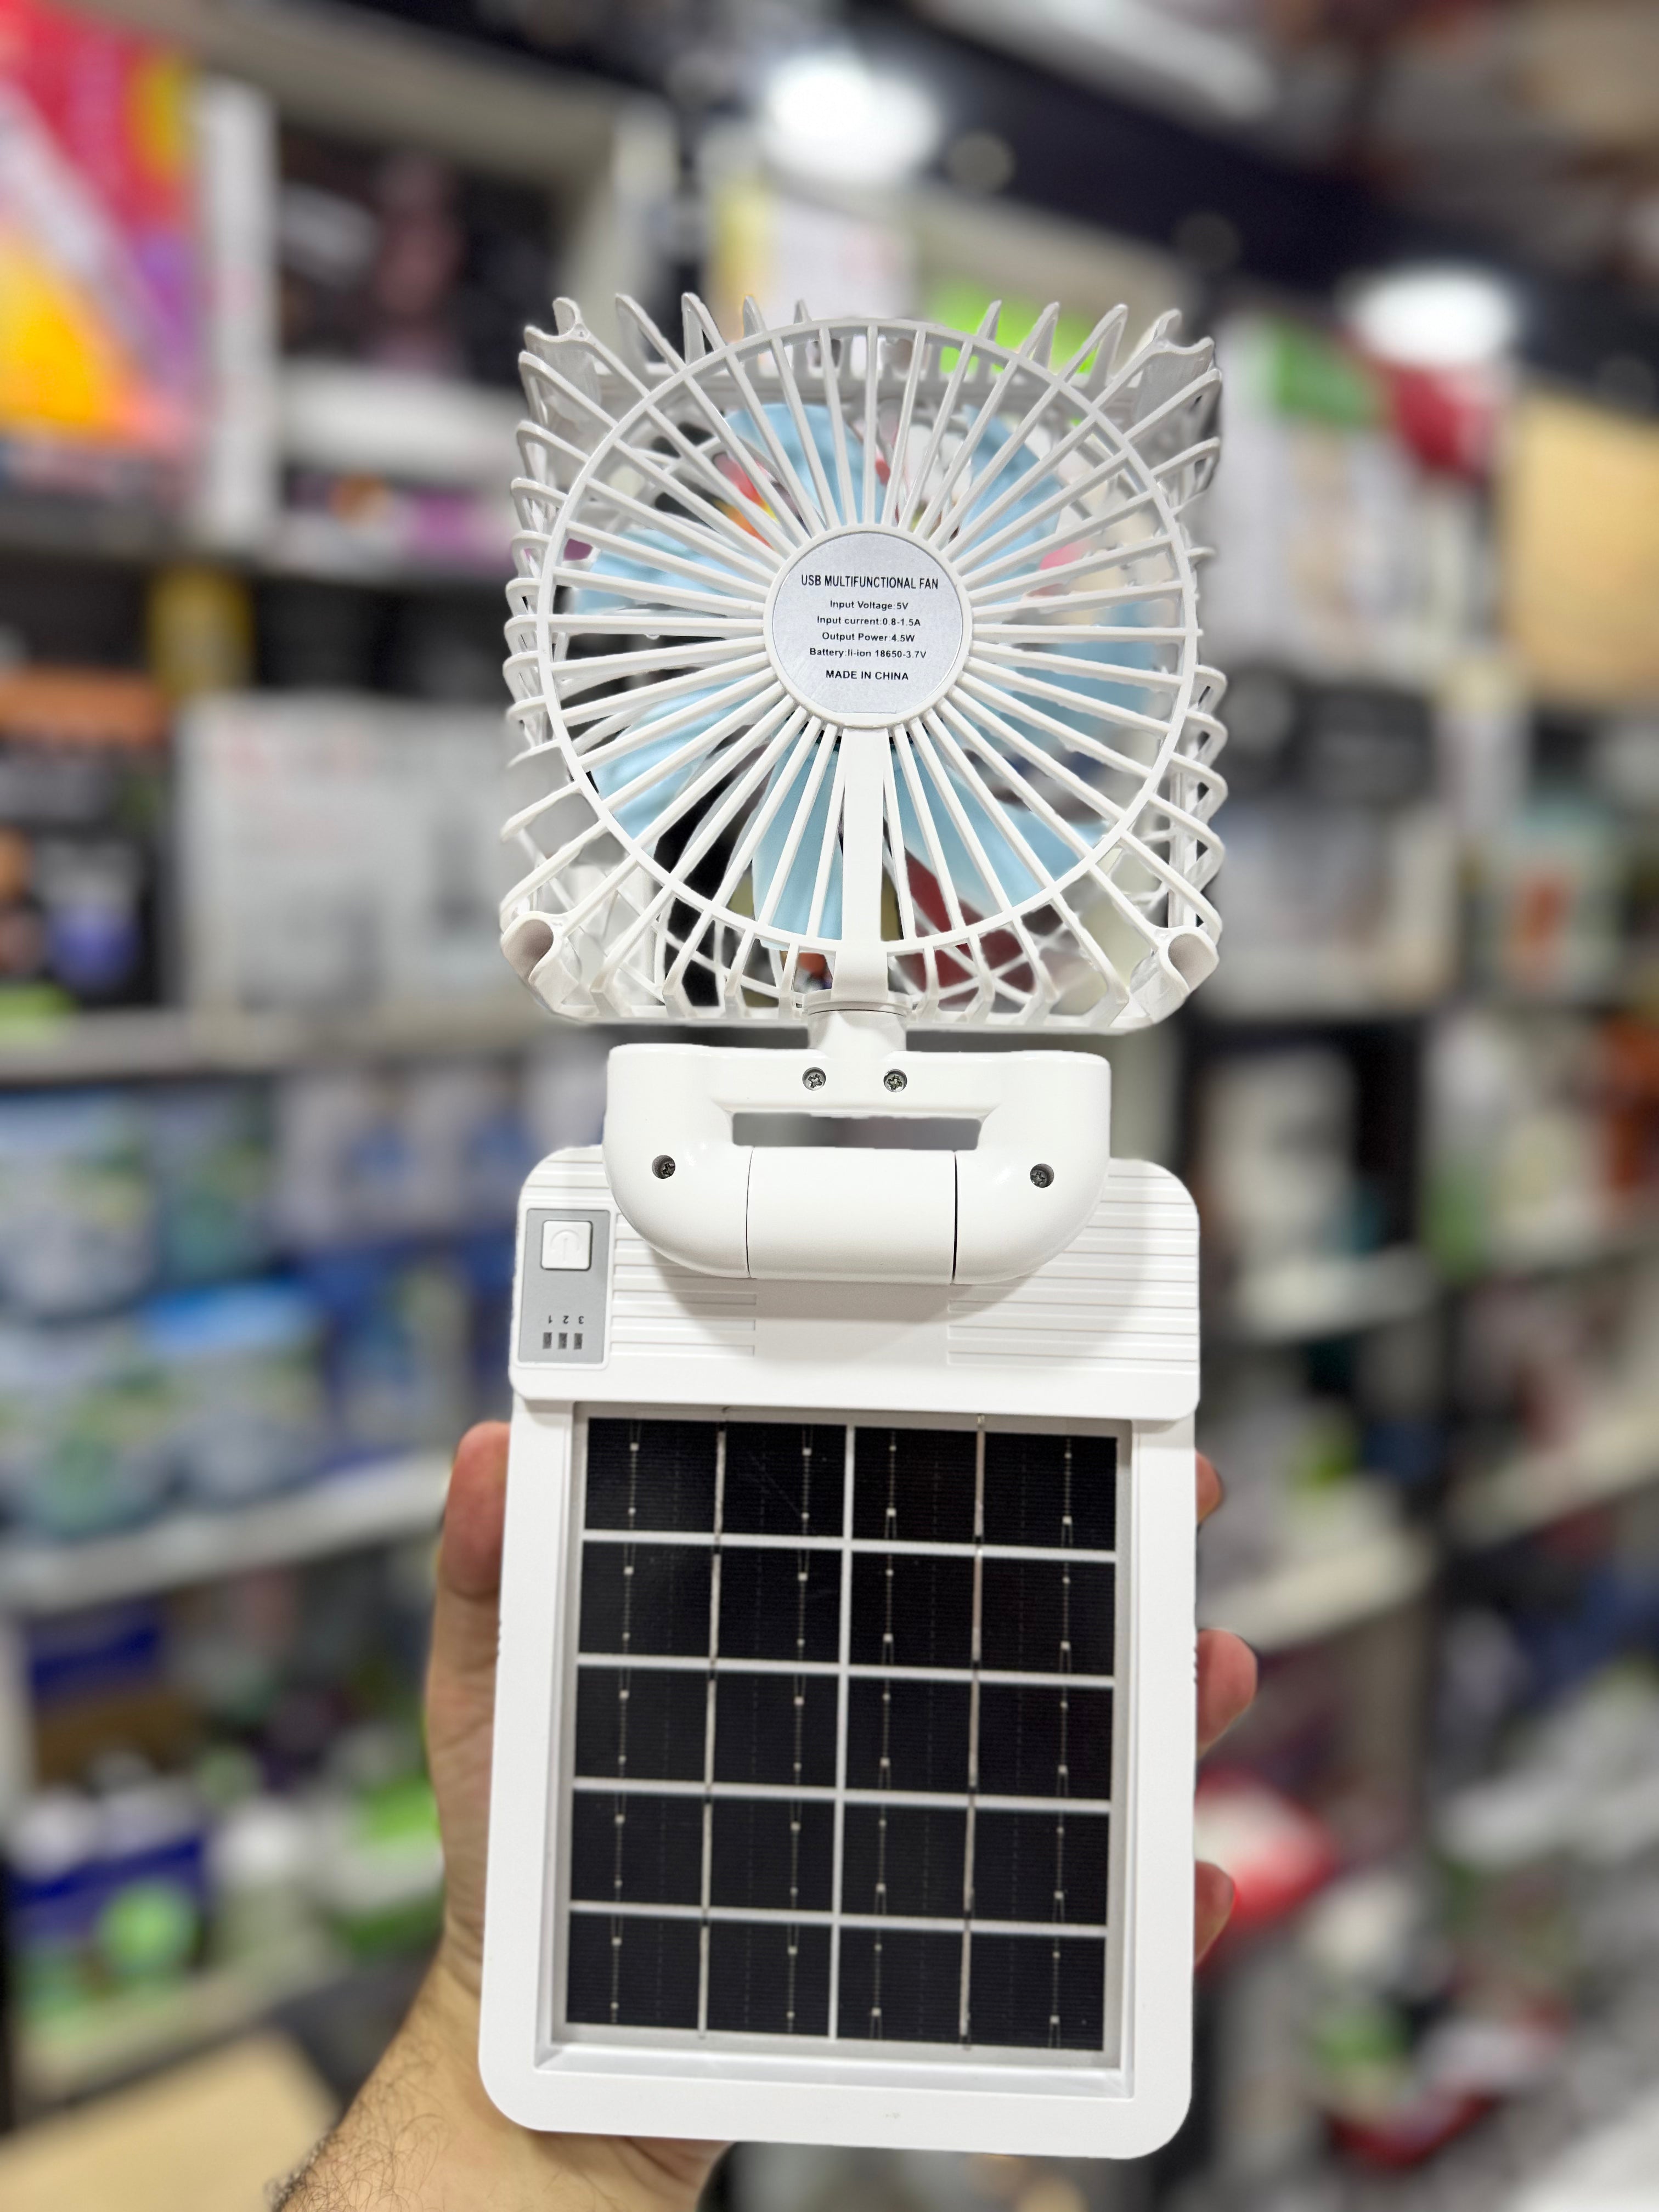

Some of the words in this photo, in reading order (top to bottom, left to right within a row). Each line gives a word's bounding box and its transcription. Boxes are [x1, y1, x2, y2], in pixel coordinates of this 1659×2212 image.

[802, 574, 821, 586] USB
[825, 575, 916, 589] MULTIFUNCTIONAL
[919, 578, 938, 589] FAN
[831, 600, 854, 610] Input
[817, 616, 841, 625] Input
[822, 632, 855, 642] Output
[826, 670, 857, 679] MADE
[861, 671, 871, 679] IN
[875, 672, 909, 680] CHINA
[548, 1315, 553, 1324] 1
[562, 1315, 569, 1324] 2
[578, 1316, 584, 1324] 3
